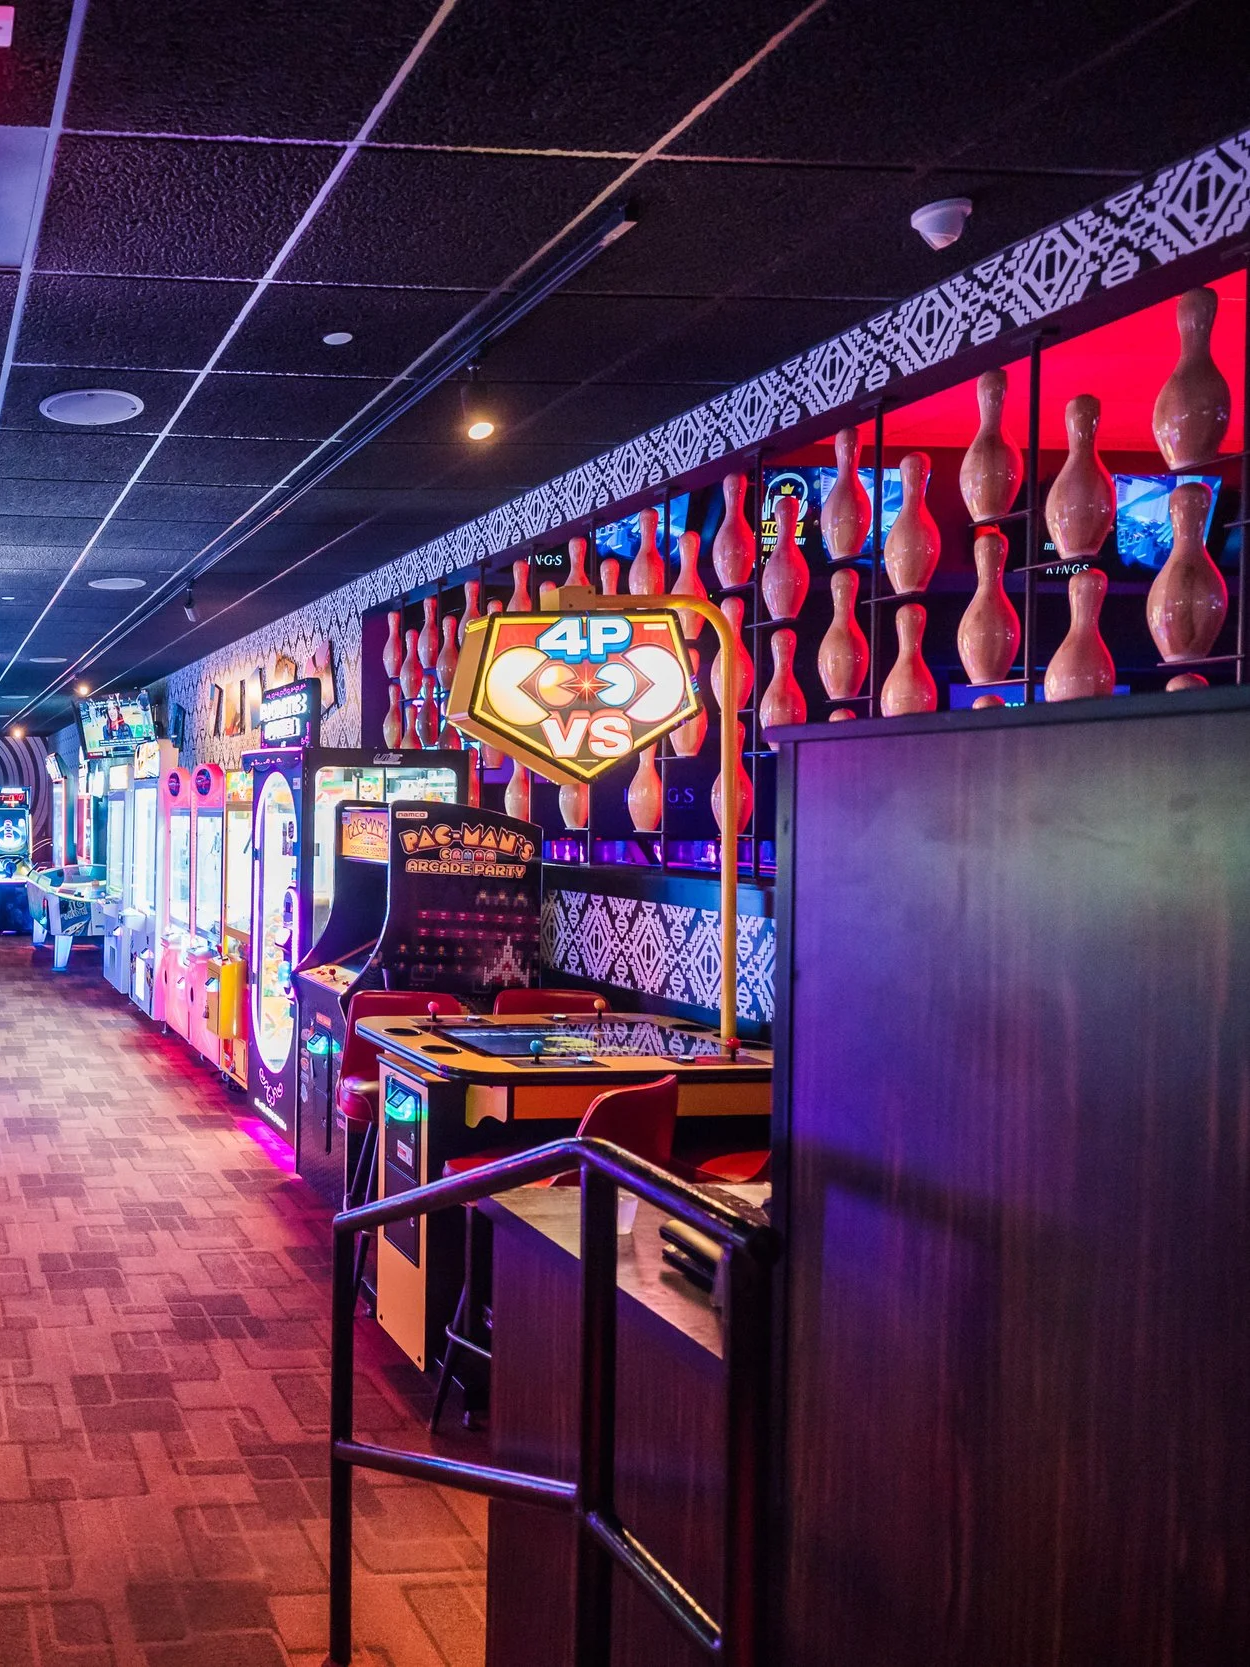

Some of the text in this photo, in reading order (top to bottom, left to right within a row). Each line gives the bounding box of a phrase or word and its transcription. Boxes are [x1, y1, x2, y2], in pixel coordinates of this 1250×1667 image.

[536, 617, 633, 664] 4P
[540, 709, 634, 758] VS
[399, 822, 535, 862] PAC-MAN'S
[406, 859, 526, 879] ARCADE PARTY
